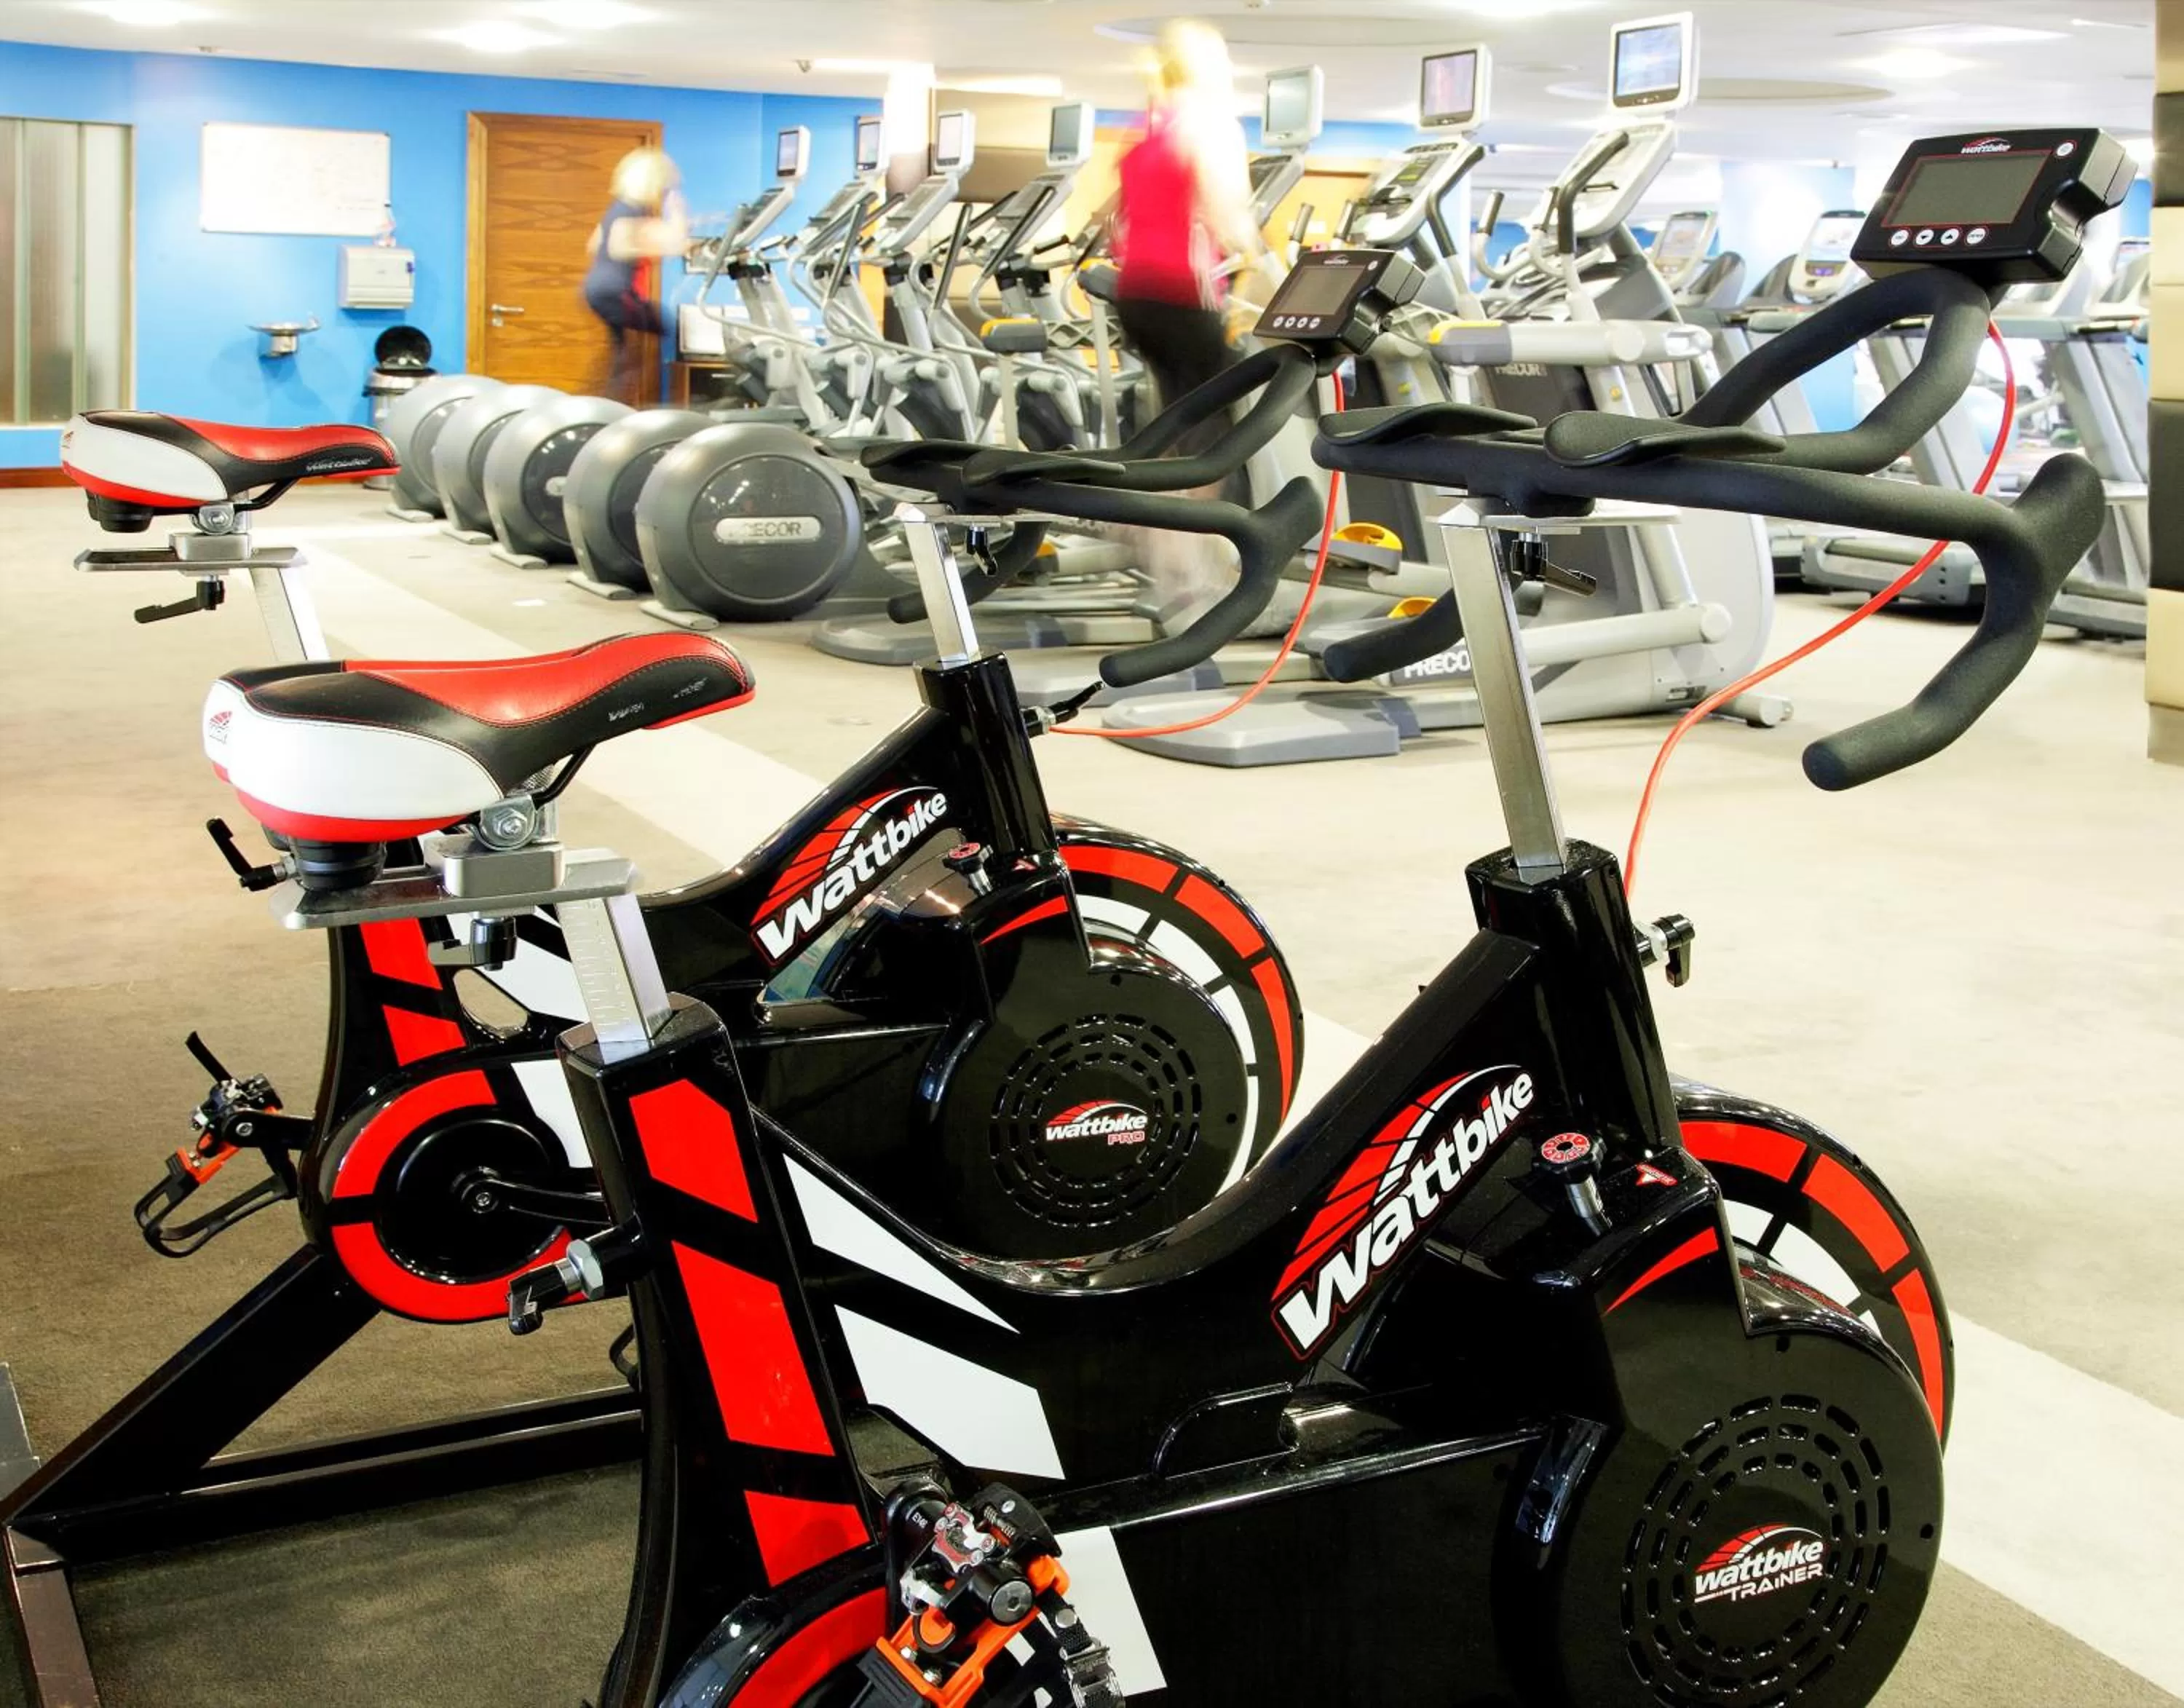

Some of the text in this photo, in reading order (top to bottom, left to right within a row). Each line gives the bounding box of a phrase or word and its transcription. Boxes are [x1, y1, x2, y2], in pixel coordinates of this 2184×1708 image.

[738, 521, 802, 537] ECOR
[1404, 649, 1471, 679] PRECO
[756, 792, 947, 960] wattbike
[1045, 1113, 1148, 1141] wattbike
[1107, 1131, 1145, 1146] PRO
[1278, 1072, 1534, 1350] wattbike
[1695, 1540, 1824, 1594] wattbike
[1727, 1562, 1823, 1602] TRAINER
